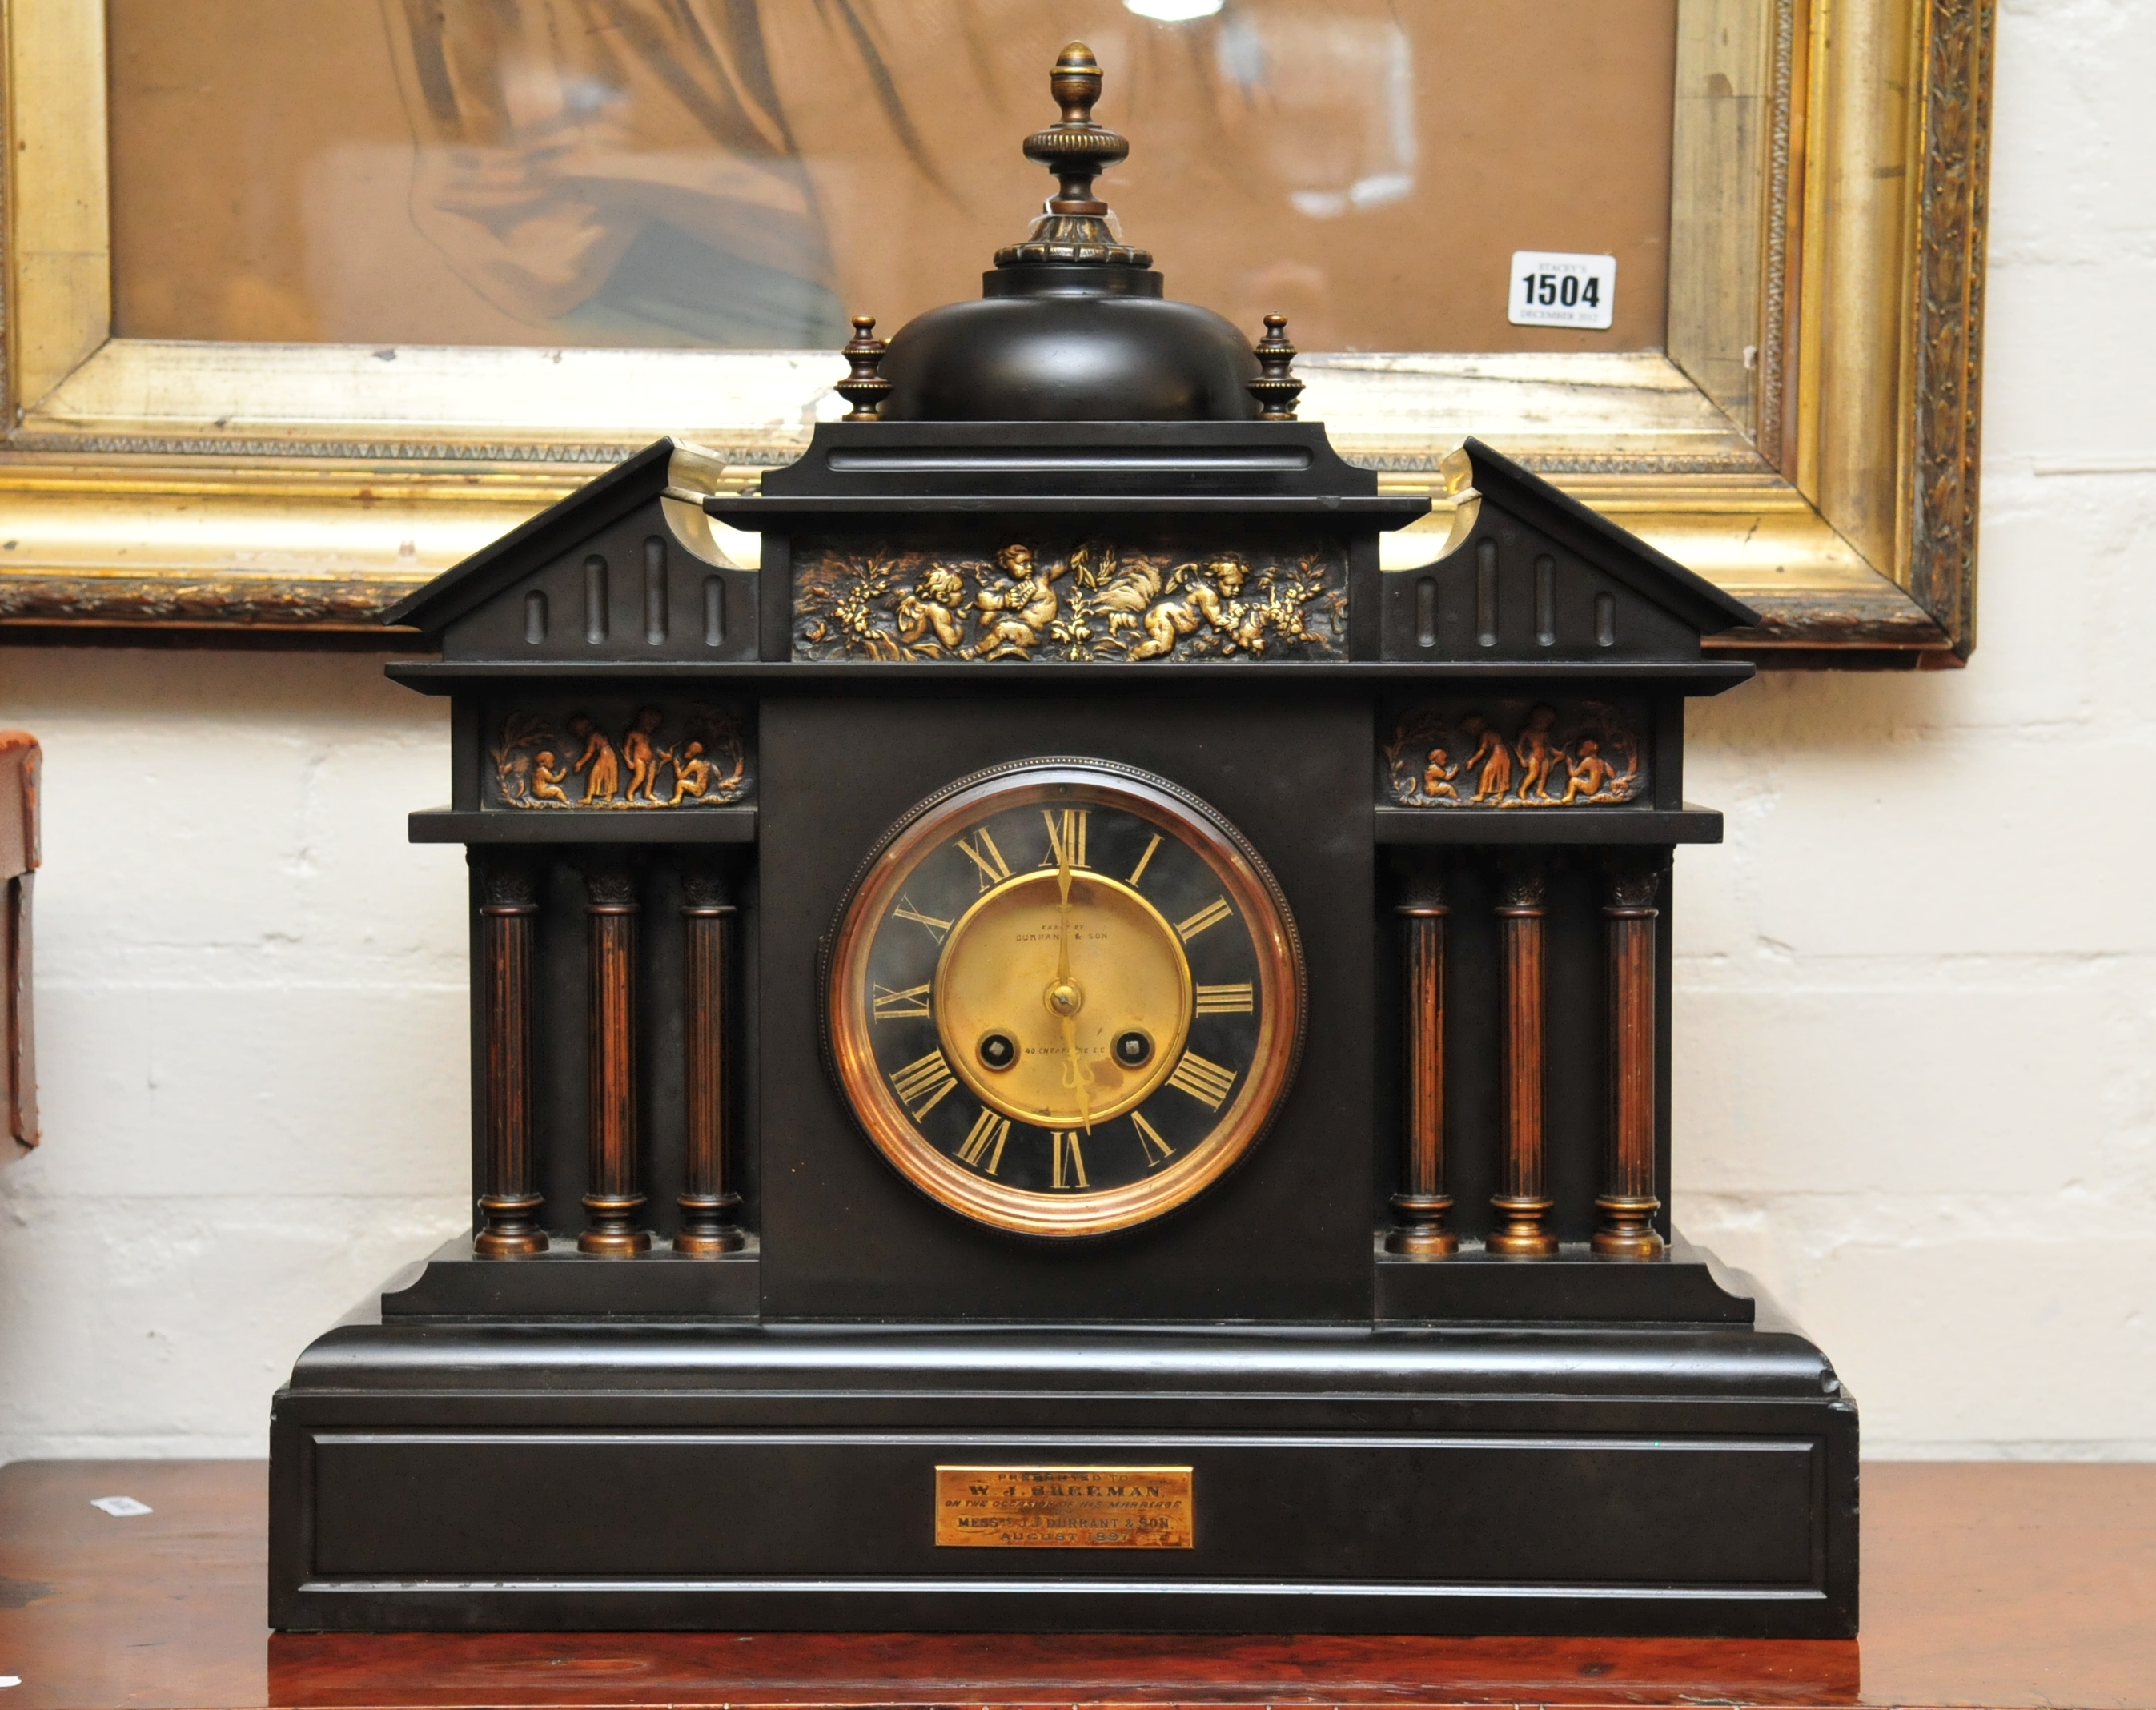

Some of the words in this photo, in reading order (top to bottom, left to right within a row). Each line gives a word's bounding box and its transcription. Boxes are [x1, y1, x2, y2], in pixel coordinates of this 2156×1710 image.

[1523, 273, 1600, 308] 1504
[1538, 263, 1587, 273] STACEY'S
[1520, 310, 1574, 320] DECEMBER
[954, 826, 1016, 893] XI
[1038, 809, 1091, 868] XII
[1125, 833, 1166, 885] I
[891, 892, 954, 945] X
[1074, 933, 1082, 941] &
[1173, 895, 1234, 945] II
[873, 979, 931, 1024] IX
[1195, 981, 1254, 1018] III
[889, 1046, 958, 1123] VIII
[1166, 1051, 1238, 1113] IIII
[953, 1105, 1012, 1176] VII
[1050, 1130, 1090, 1190] VI
[1130, 1110, 1177, 1167] V
[1110, 1475, 1129, 1483] TO
[945, 1499, 962, 1507] ON
[965, 1499, 988, 1507] THE
[992, 1499, 1054, 1508] OCCASION
[1059, 1500, 1076, 1508] OF
[1107, 1501, 1182, 1509] MARRIAGE
[1046, 1518, 1118, 1528] DURRANT
[1125, 1519, 1134, 1528] &
[999, 1532, 1078, 1541] AUGUST
[1088, 1532, 1130, 1541] 1897
